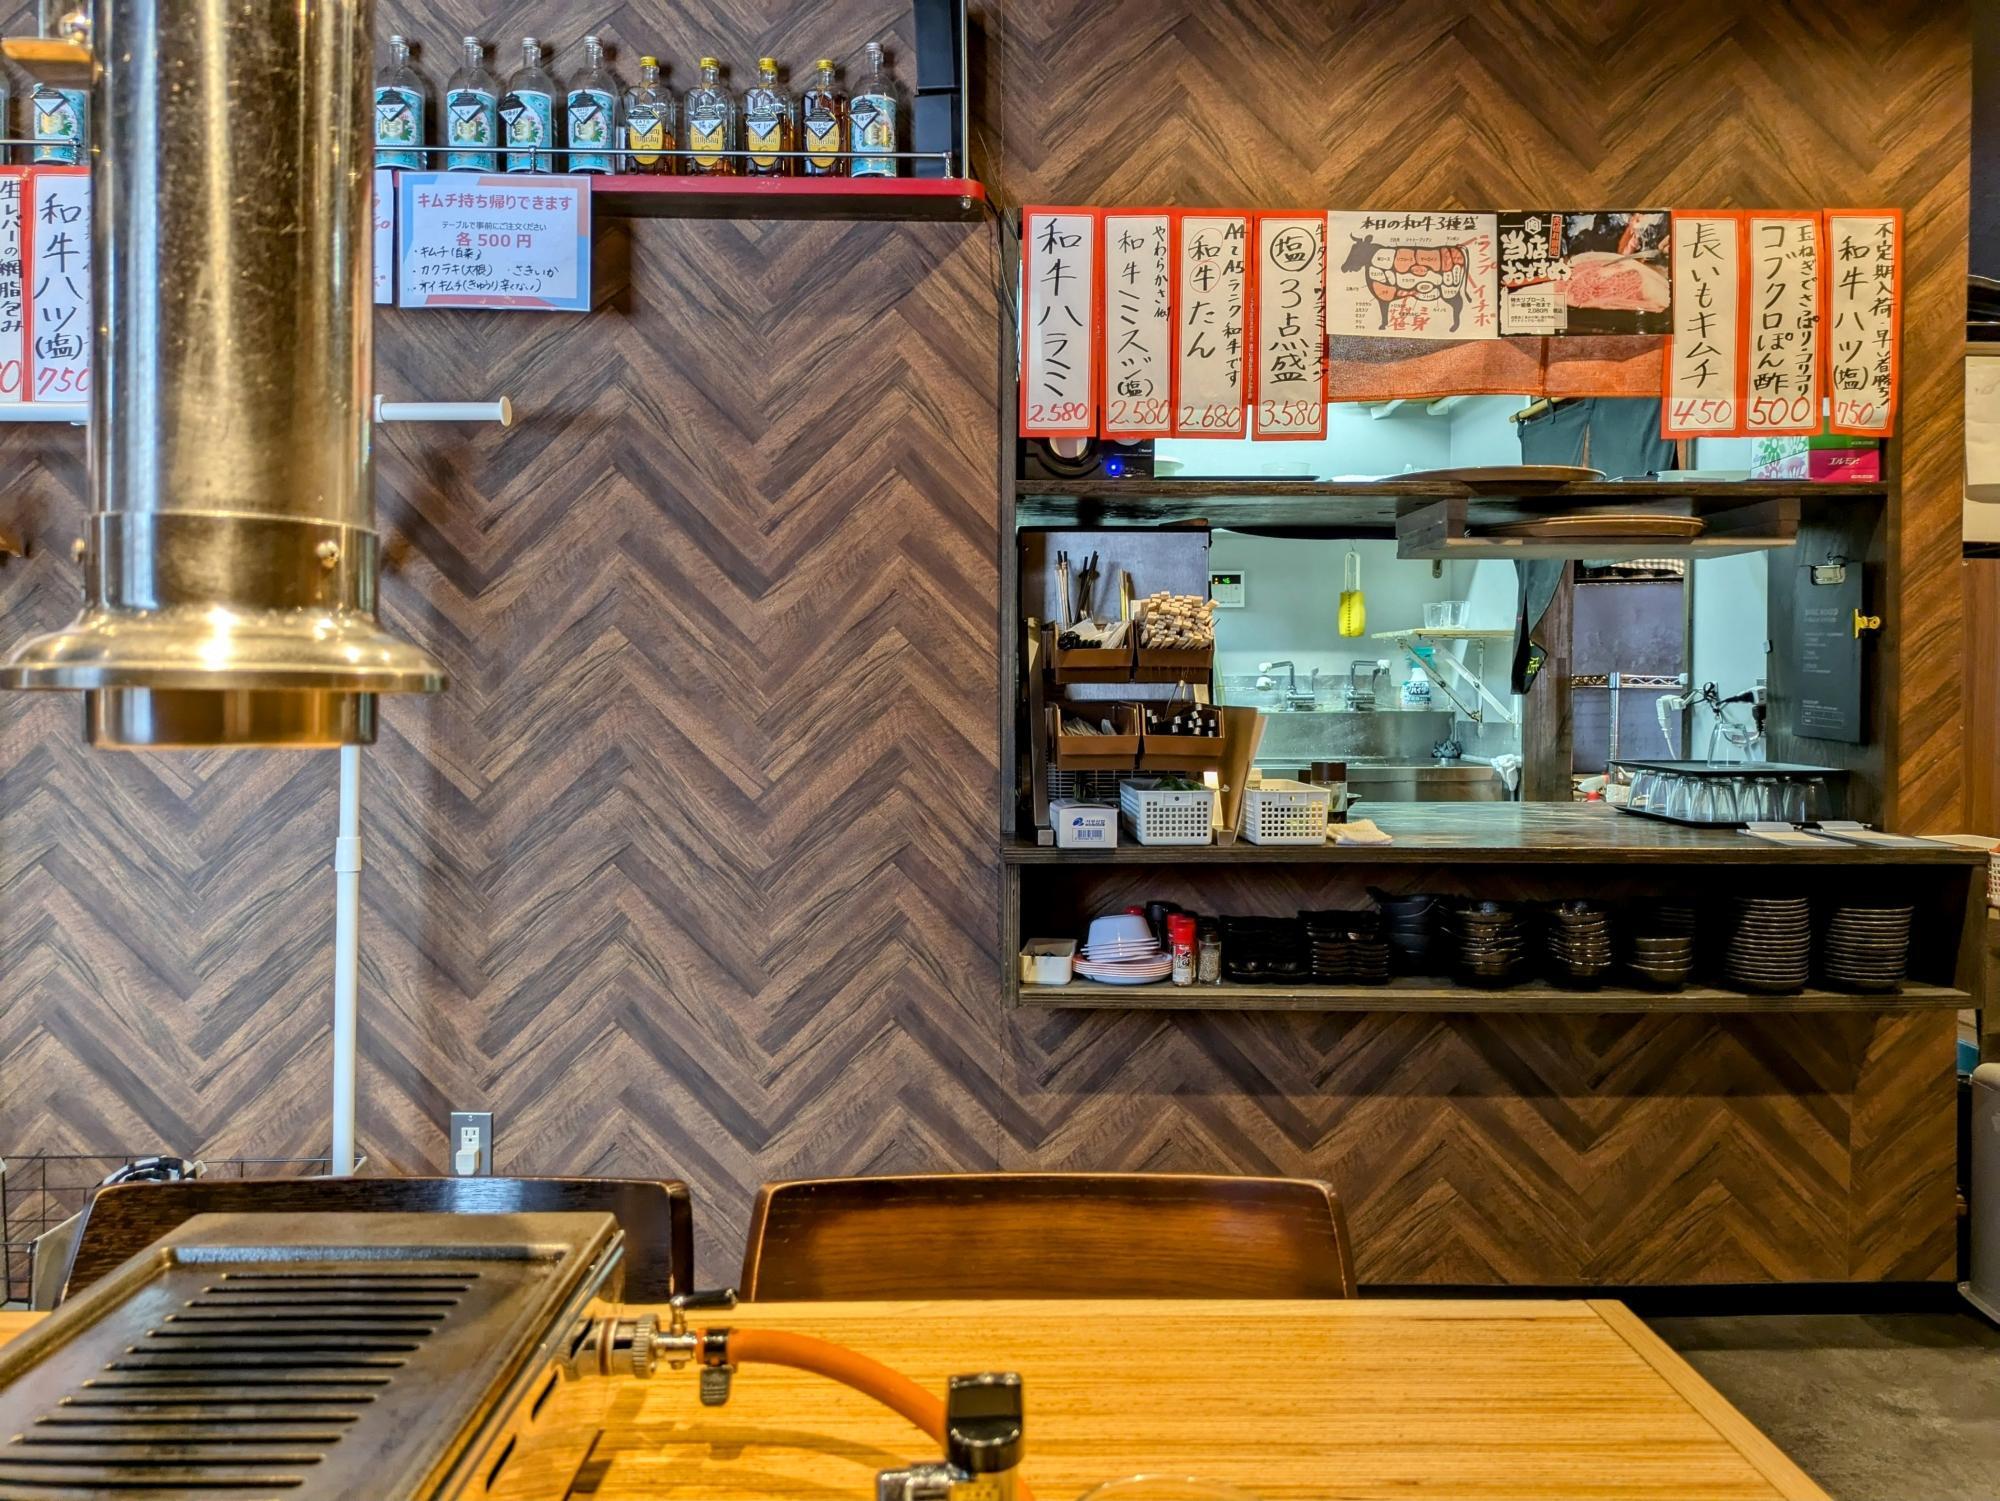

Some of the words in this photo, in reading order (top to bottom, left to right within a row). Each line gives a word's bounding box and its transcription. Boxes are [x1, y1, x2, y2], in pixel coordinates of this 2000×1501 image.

[417, 192, 573, 211] キムチ持ち帰りできます
[441, 221, 547, 232] テーブルで事前にご注文ください
[1360, 215, 1478, 232] 本日の和牛3種盛
[456, 232, 472, 248] 各
[477, 234, 511, 248] 500
[516, 234, 532, 248] 円
[1477, 234, 1497, 275] ランプ
[1500, 230, 1549, 261] 当店
[33, 192, 84, 361] 和牛ハツ(塩)
[1501, 258, 1573, 284] おすすめ
[1037, 218, 1083, 397] 和牛ハラミ
[1187, 231, 1222, 359] 和牛たん
[1680, 222, 1725, 389] 長いもキムチ
[1753, 226, 1796, 394] コブクロぽん酢
[1116, 229, 1154, 398] 和牛ミスジ(塩)
[1834, 235, 1871, 391] 和牛ハツ(塩)
[1674, 400, 1732, 425] 450
[1749, 396, 1811, 425] 500
[1838, 399, 1874, 425] 750
